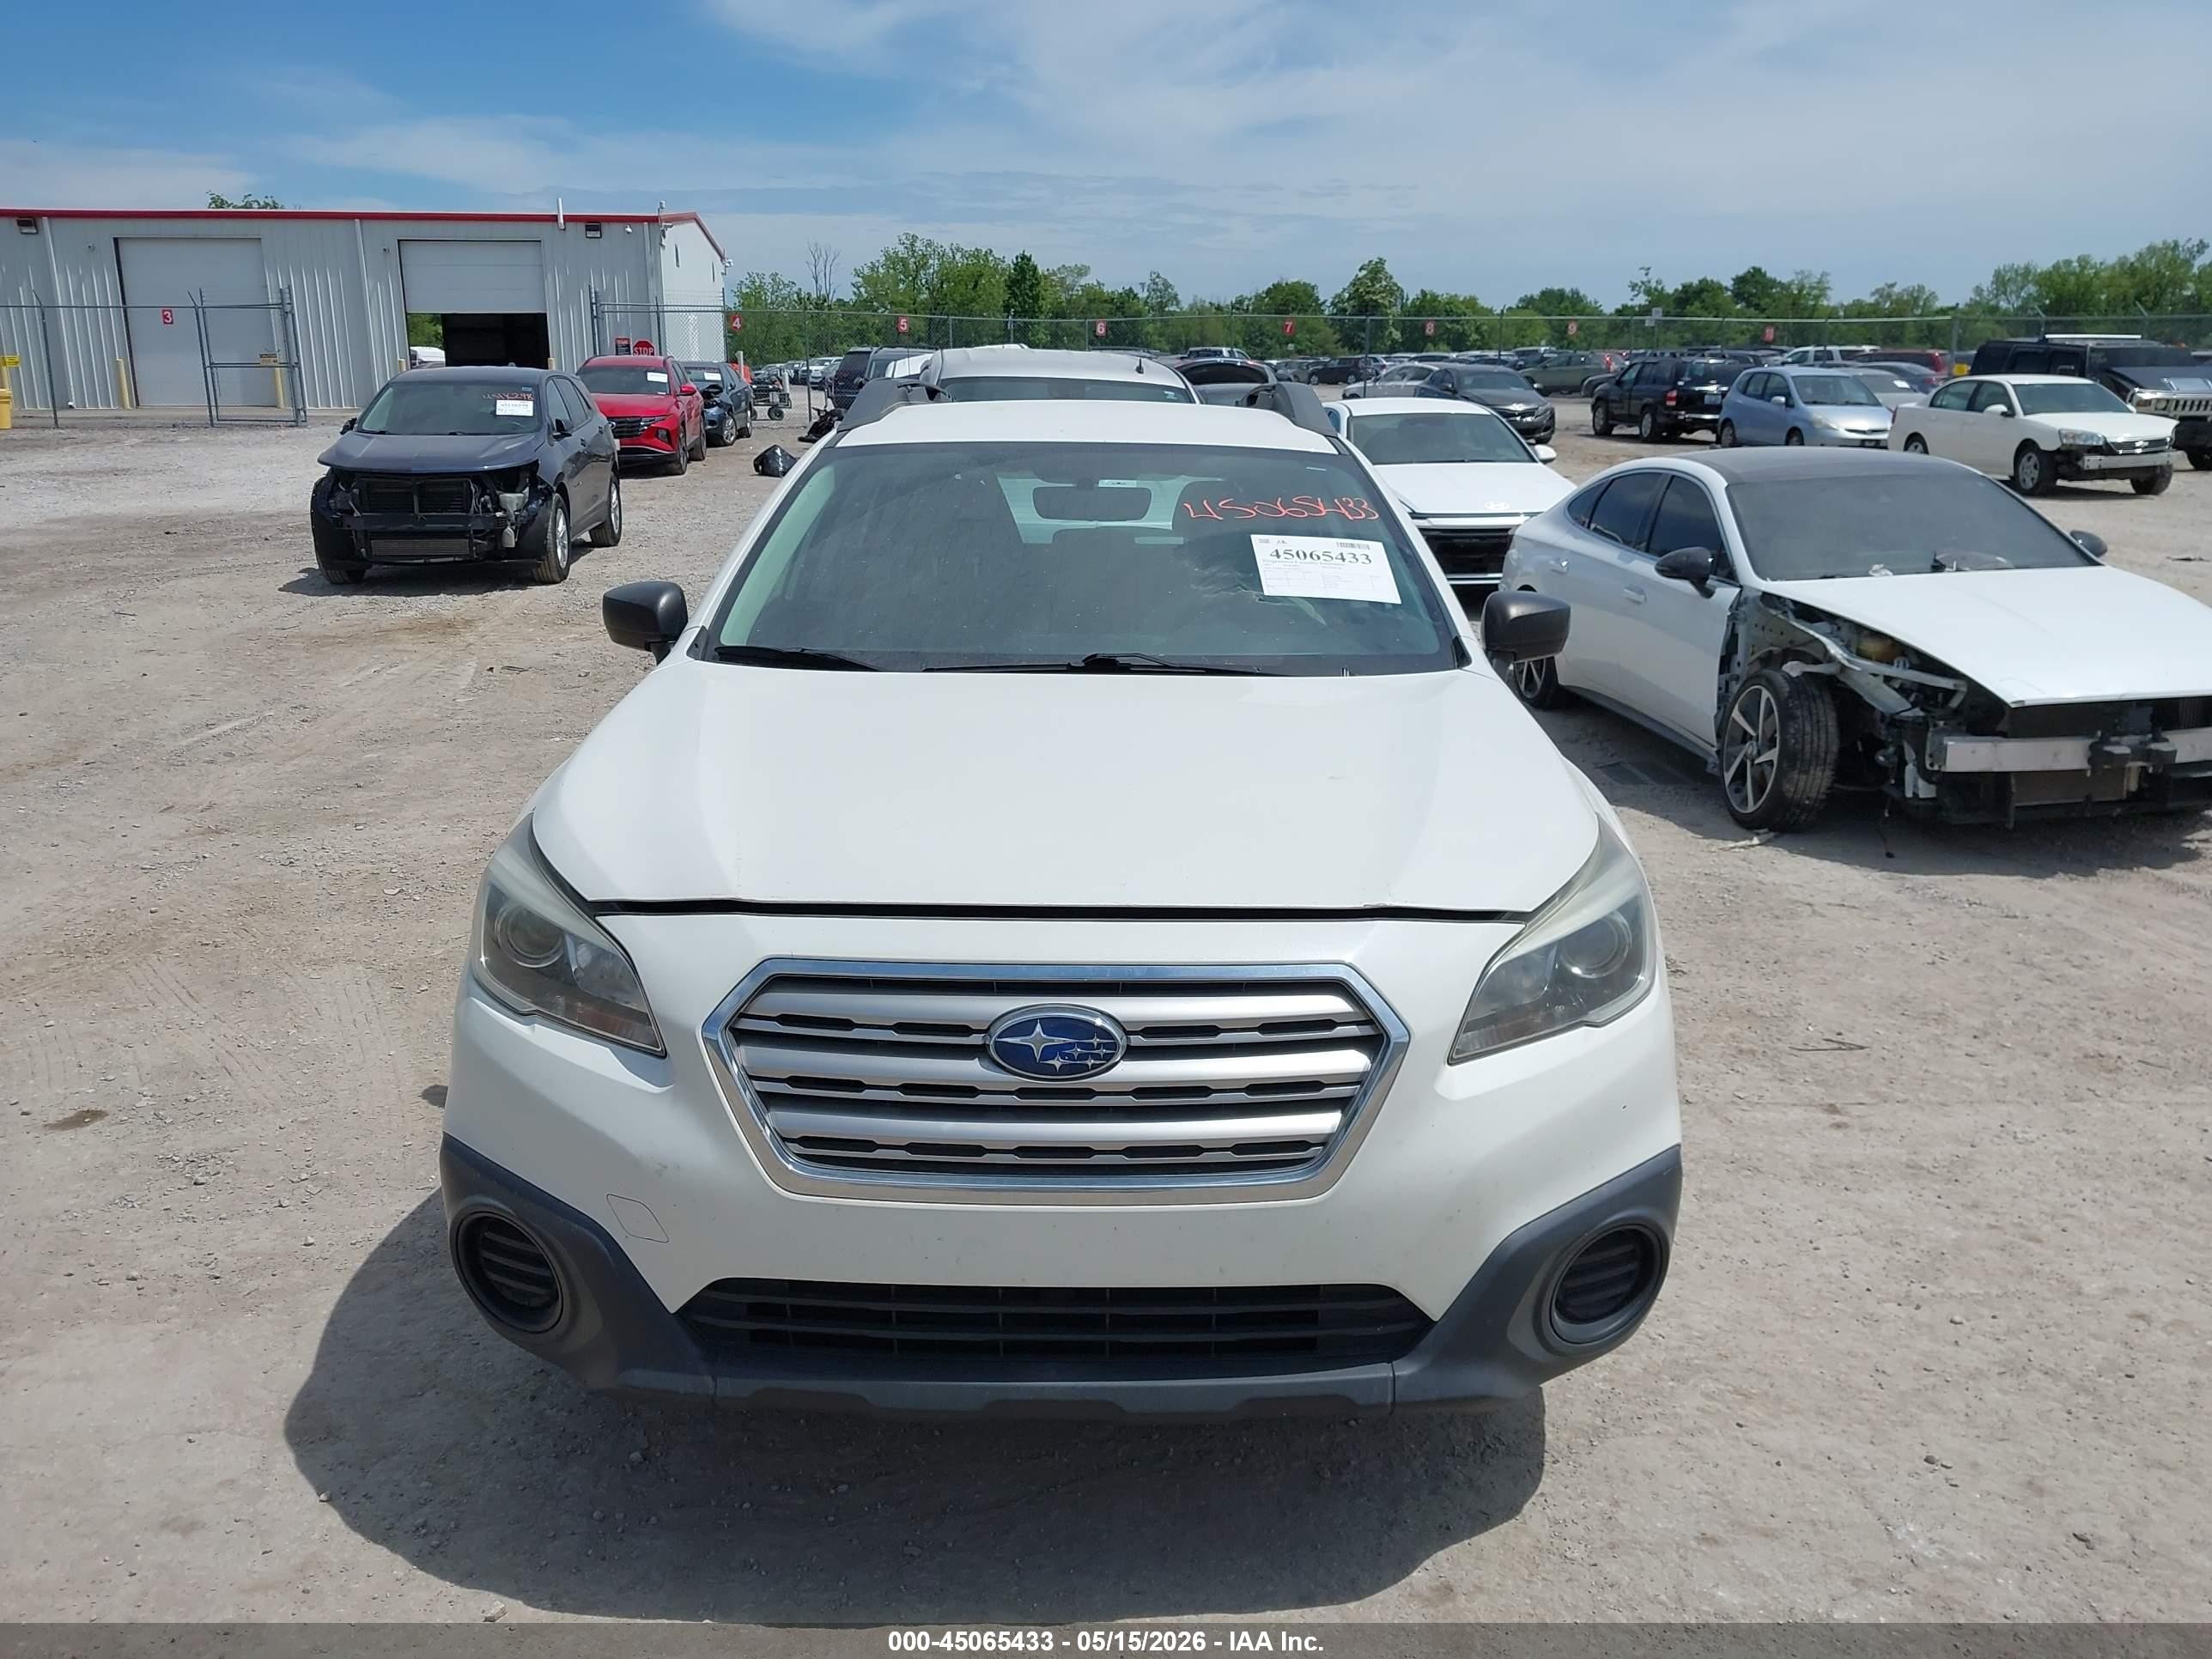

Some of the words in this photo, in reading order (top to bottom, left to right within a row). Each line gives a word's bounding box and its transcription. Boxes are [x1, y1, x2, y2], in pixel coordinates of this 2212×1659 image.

[163, 311, 173, 324] 3
[732, 318, 742, 329] 4
[901, 319, 908, 331] 5
[1097, 322, 1105, 334] 6
[1285, 322, 1292, 333] 7
[1567, 323, 1577, 335] 9
[635, 346, 653, 356] STOP
[1183, 495, 1379, 520] 45065433
[1270, 548, 1372, 564] 45065433
